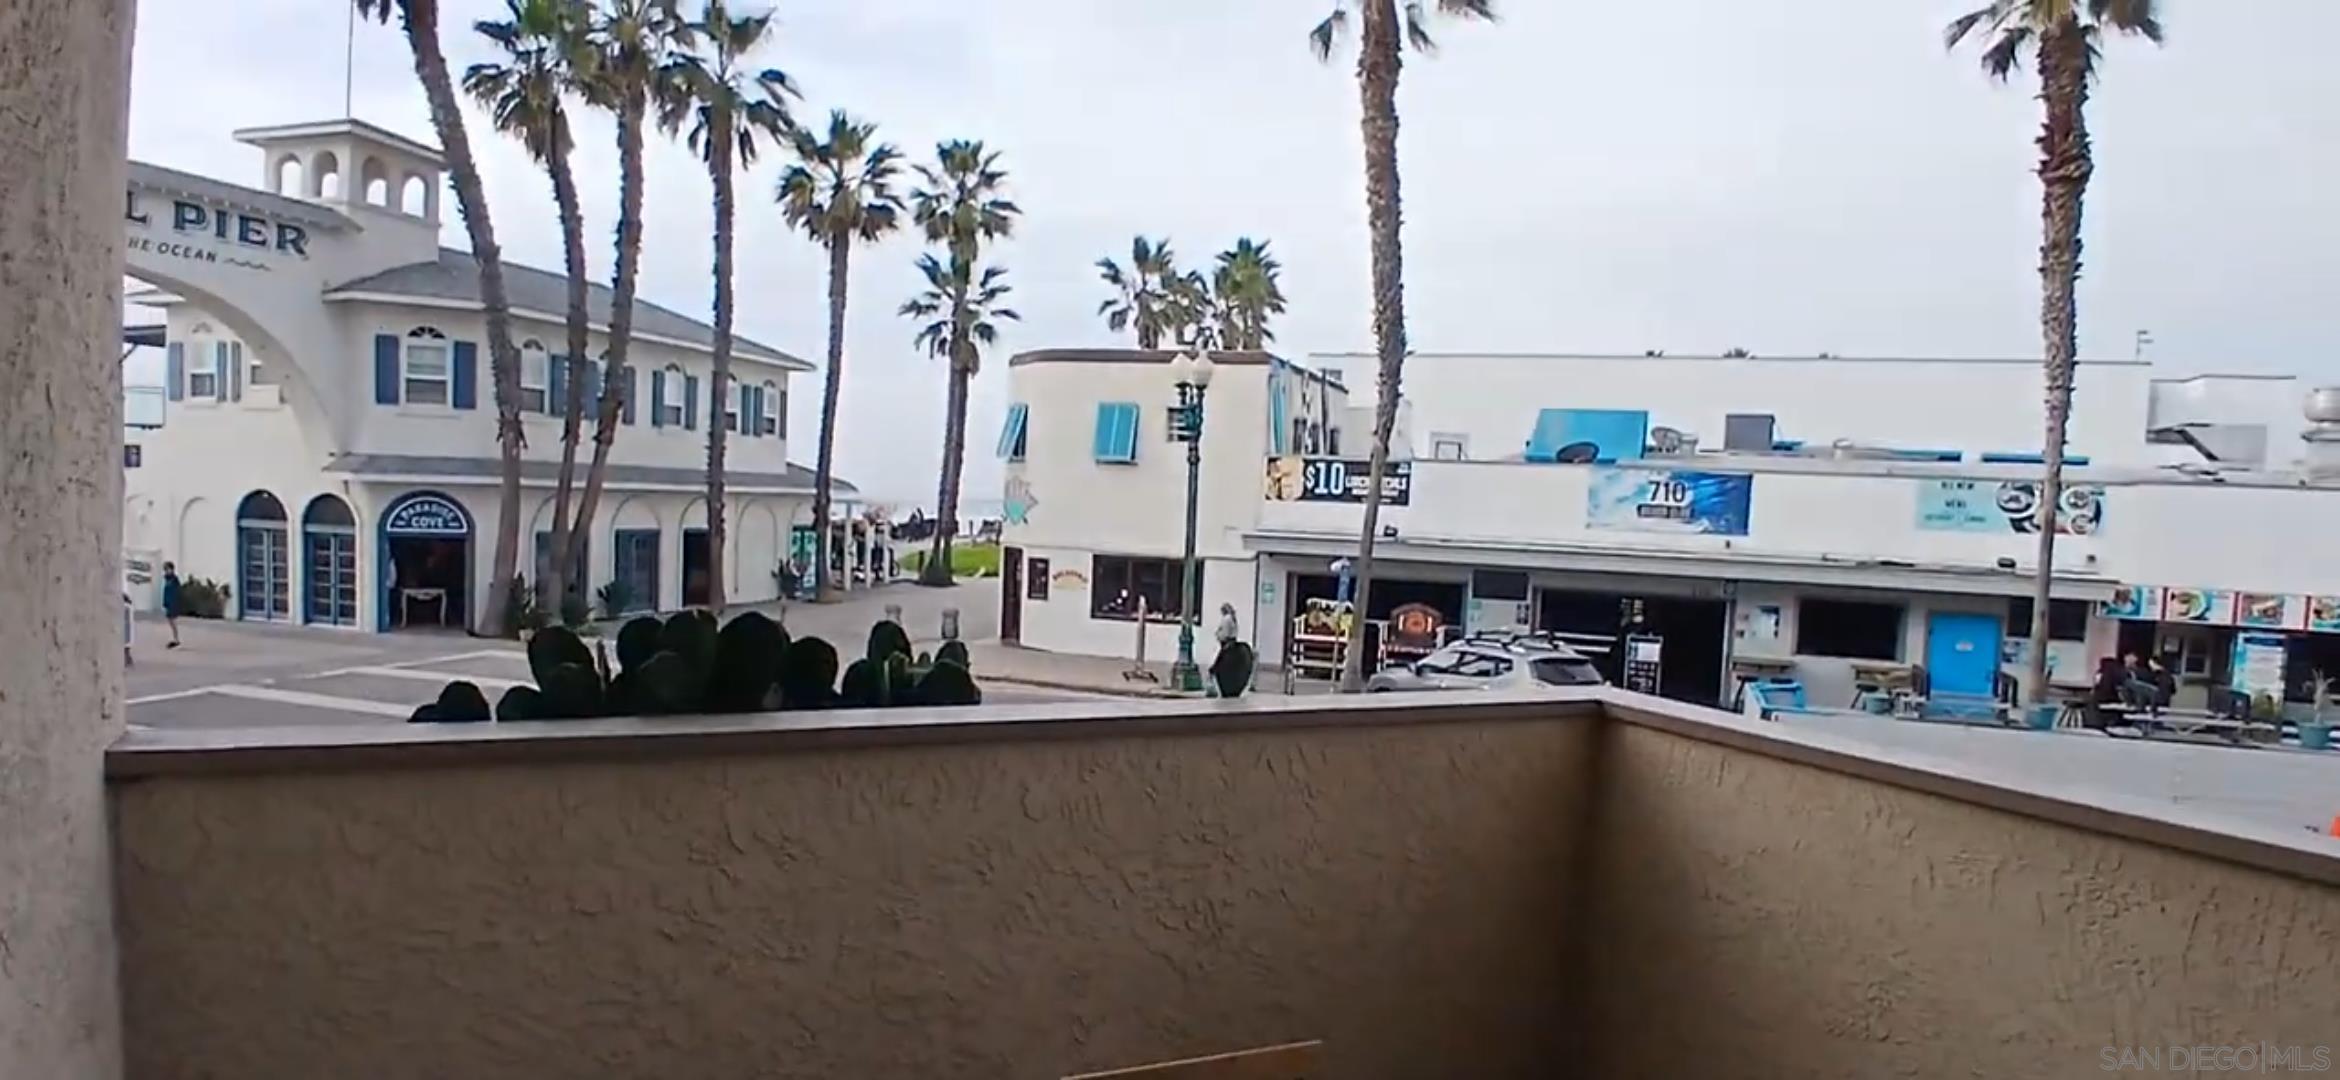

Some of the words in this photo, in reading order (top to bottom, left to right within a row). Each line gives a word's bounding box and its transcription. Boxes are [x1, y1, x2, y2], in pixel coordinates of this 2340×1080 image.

[173, 200, 309, 258] PIER
[157, 241, 217, 263] OCEAN
[1305, 462, 1346, 495] $10
[1648, 481, 1687, 503] 710
[410, 516, 444, 528] COVE
